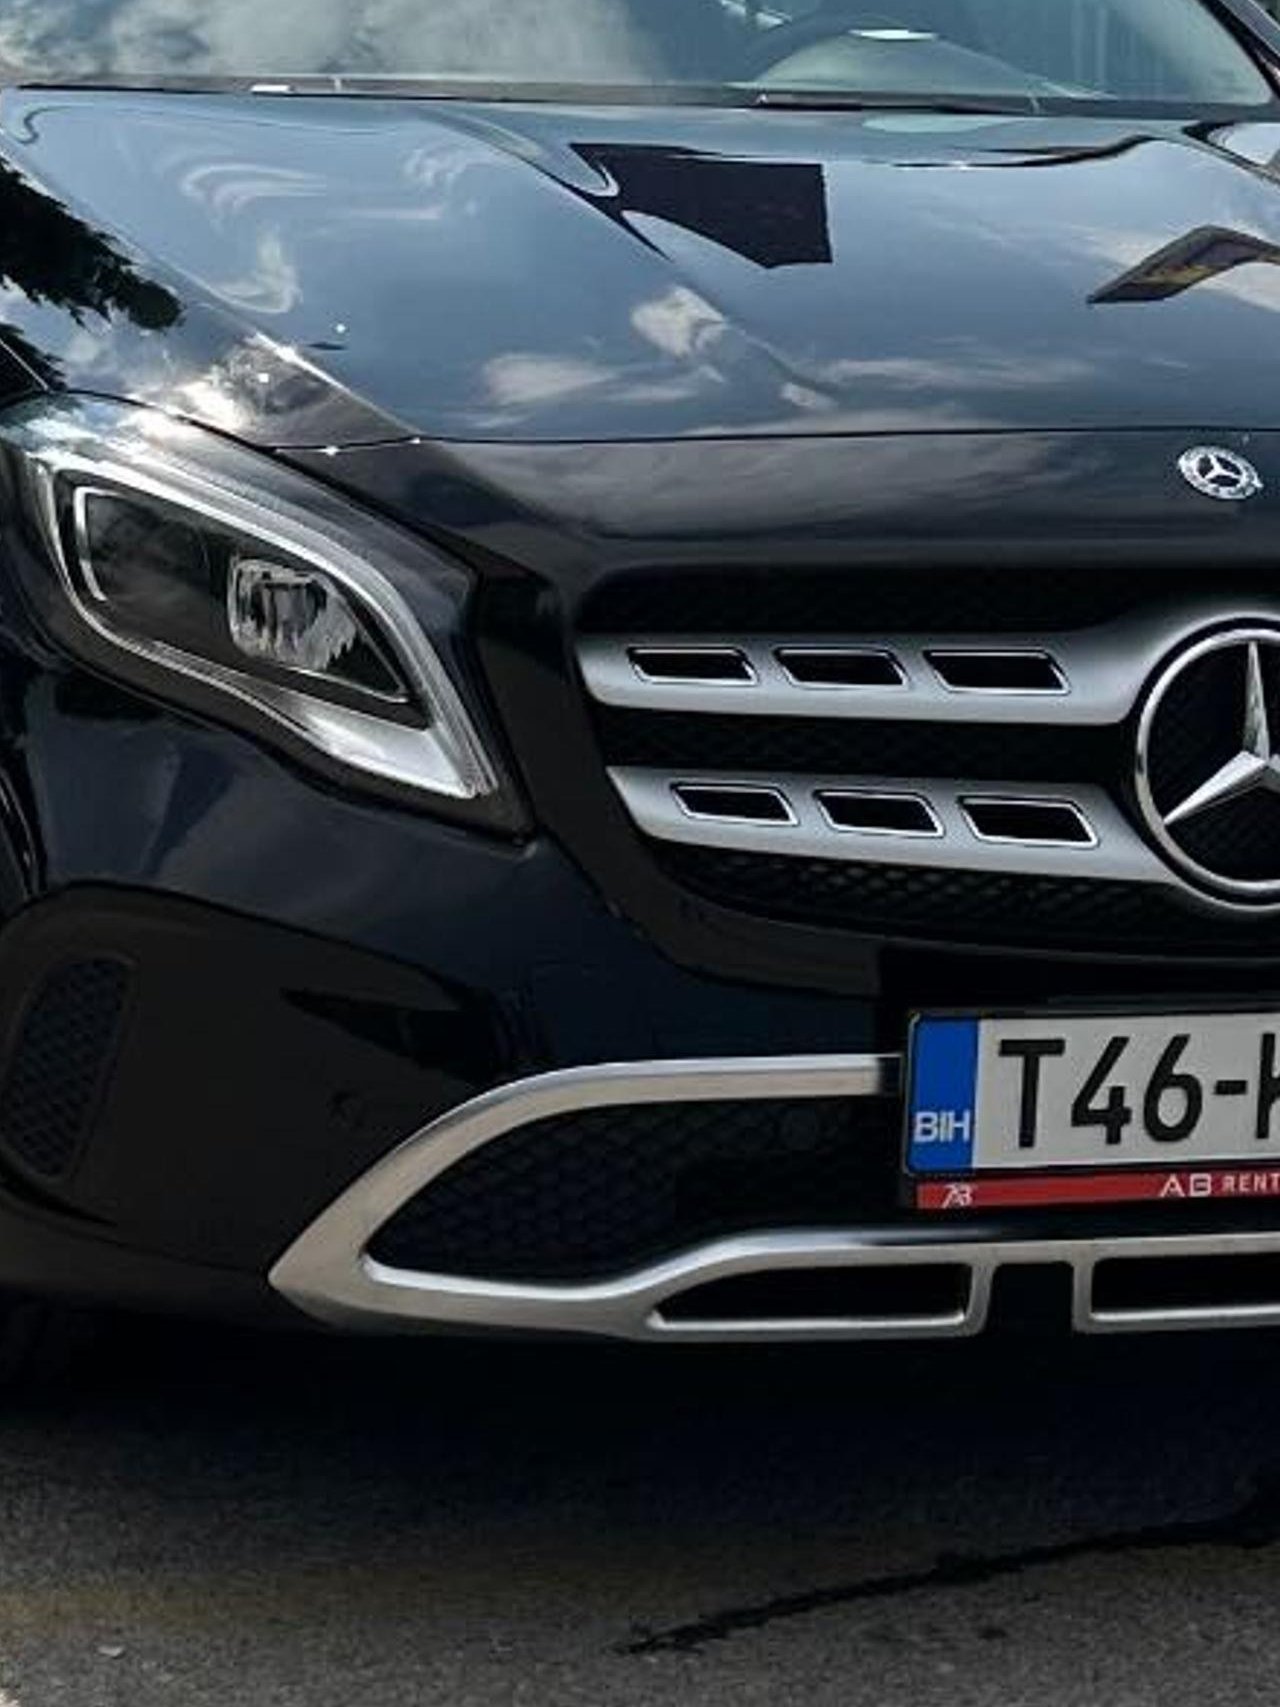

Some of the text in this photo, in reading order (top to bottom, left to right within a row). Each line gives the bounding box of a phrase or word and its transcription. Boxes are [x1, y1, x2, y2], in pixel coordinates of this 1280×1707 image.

[913, 1108, 972, 1143] BIH
[1160, 1172, 1212, 1198] AB
[1221, 1170, 1280, 1194] RENT
